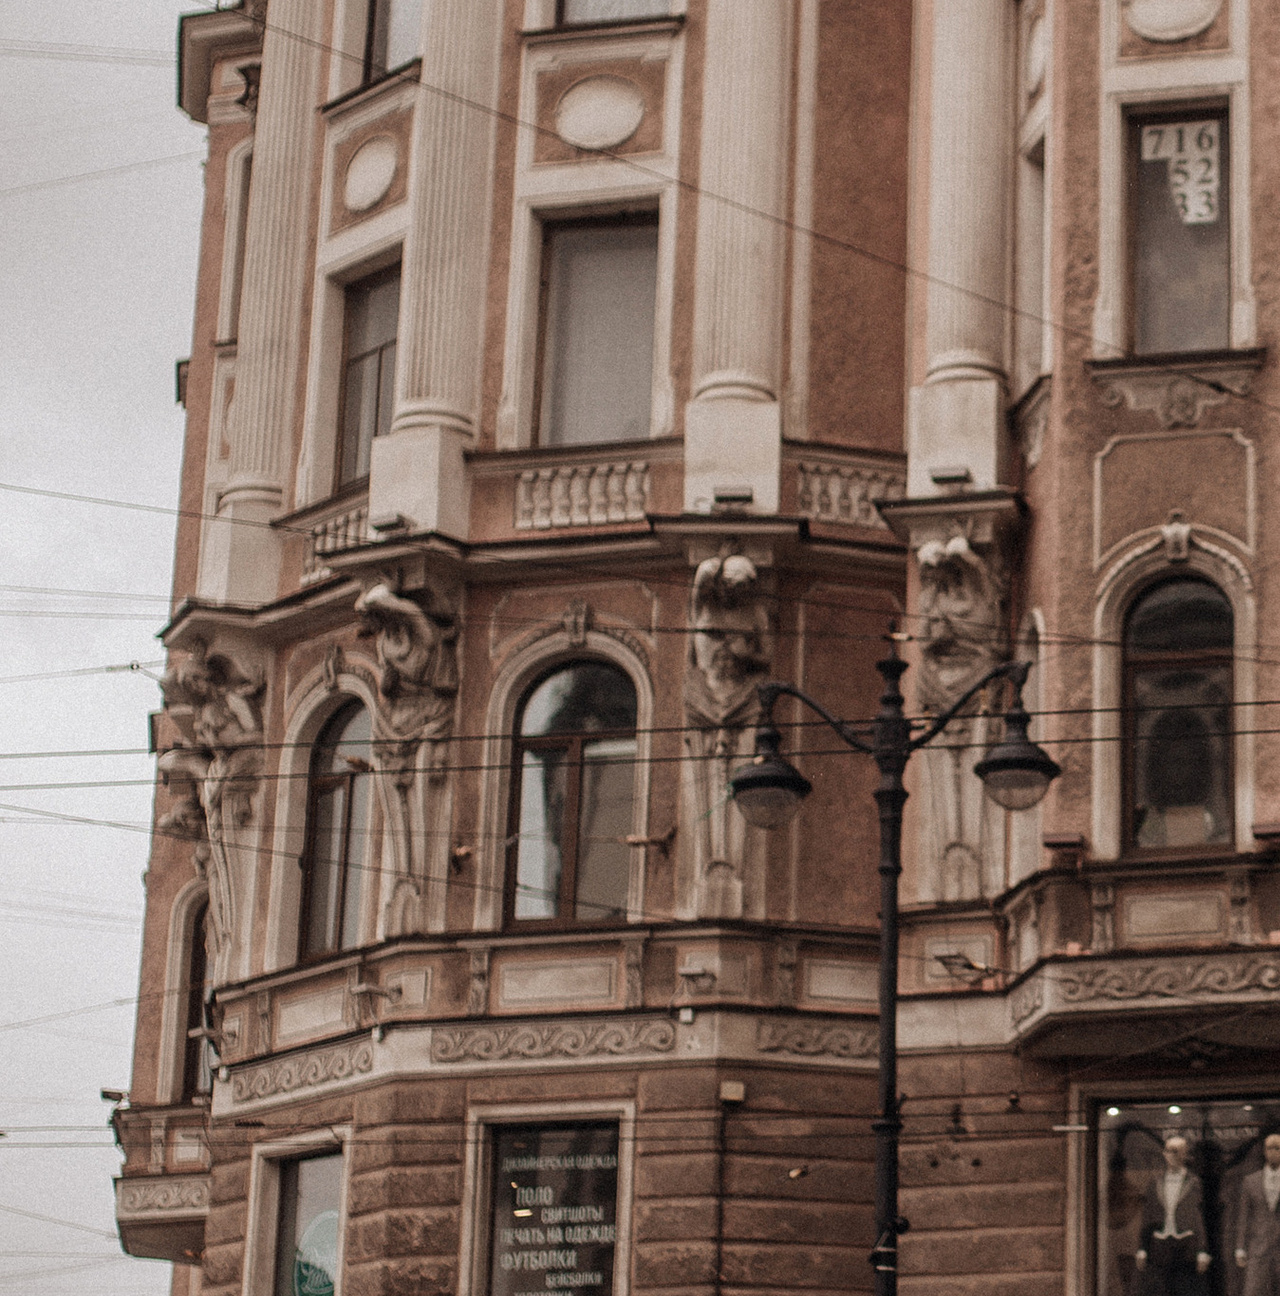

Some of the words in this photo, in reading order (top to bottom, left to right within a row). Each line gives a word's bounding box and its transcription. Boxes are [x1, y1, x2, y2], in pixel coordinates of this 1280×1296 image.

[1148, 125, 1214, 155] 716
[1173, 157, 1213, 187] 52
[516, 1186, 554, 1206] ПОЛО
[540, 1206, 604, 1224] СВИТШОТЫ
[500, 1227, 545, 1245] ПЕЧАТЬ
[546, 1226, 563, 1244] НА
[500, 1249, 578, 1271] ФУТБОЛКИ
[545, 1271, 603, 1288] БЕЙСБОЛКИ
